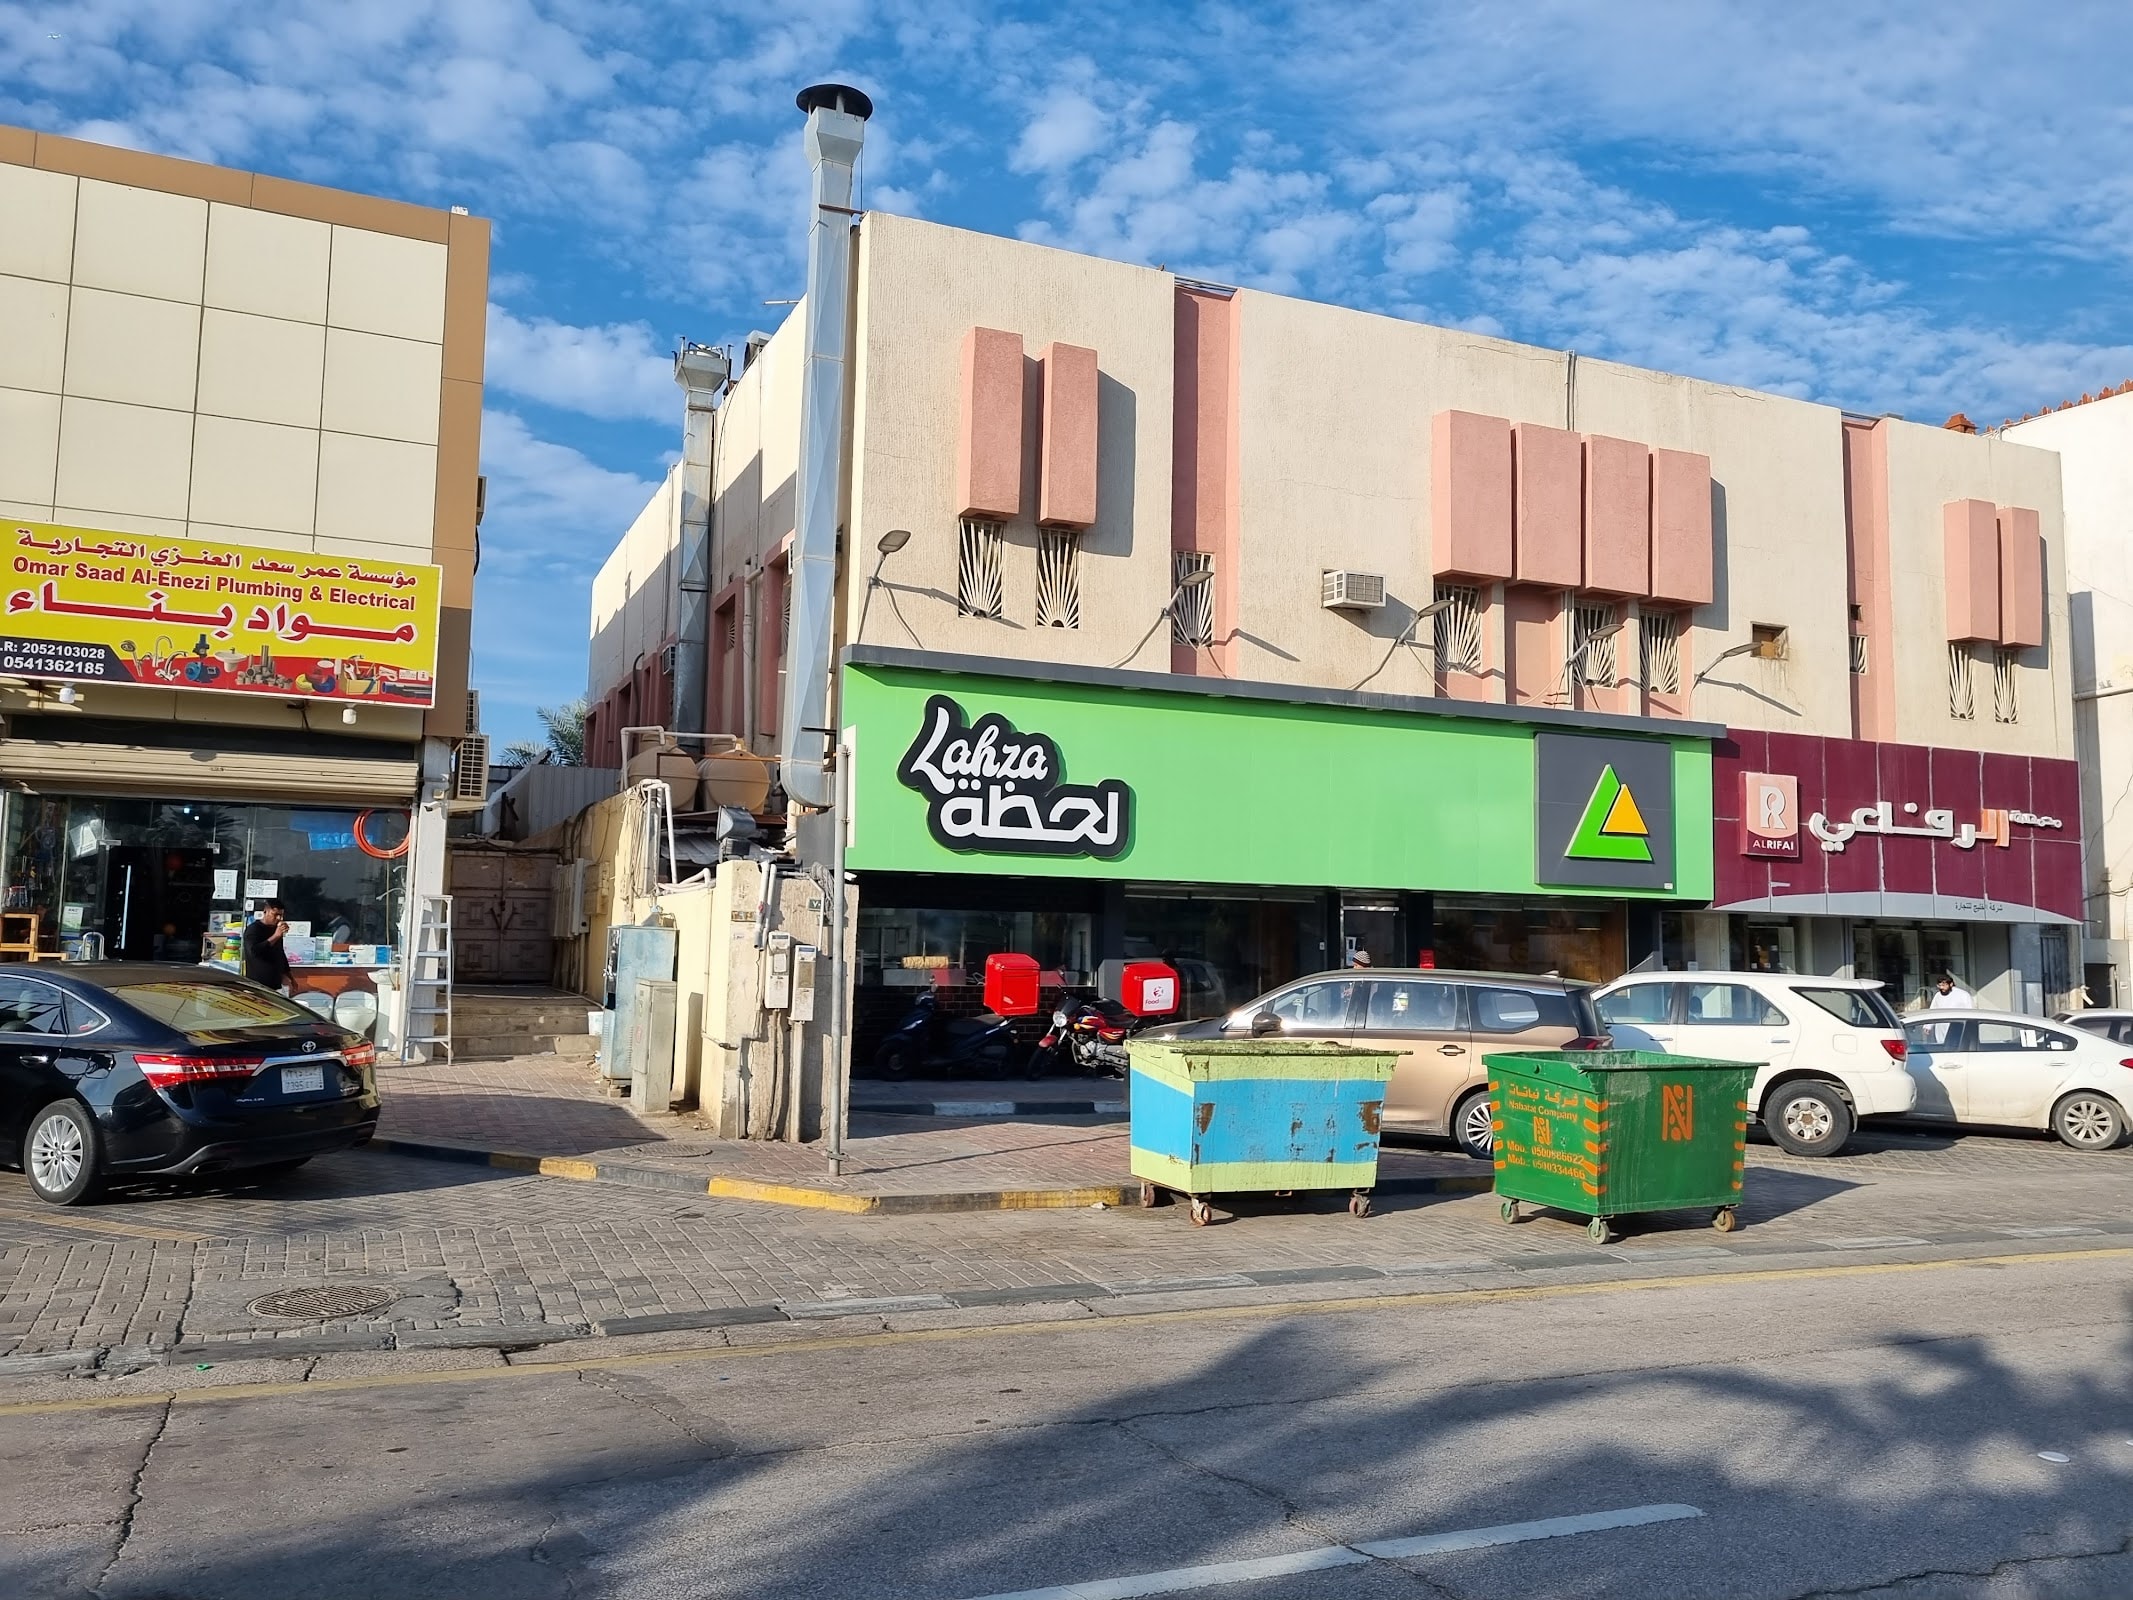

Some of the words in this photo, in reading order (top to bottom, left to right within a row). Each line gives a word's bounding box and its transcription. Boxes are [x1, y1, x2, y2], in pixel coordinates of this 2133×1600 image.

[18, 528, 145, 558] التجارية
[150, 547, 241, 569] العنزي
[251, 558, 295, 573] سعد
[13, 556, 70, 577] Omar
[75, 562, 125, 583] Saad
[131, 568, 210, 591] Al-Enezi
[216, 576, 303, 602] Plumbing
[309, 586, 323, 601] &
[329, 588, 415, 611] Electrical
[299, 565, 342, 579] عمر
[348, 564, 417, 588] مؤسسة
[9, 582, 233, 639] بناء
[247, 604, 415, 643] مواد
[22, 642, 106, 660] 2052103028
[3, 656, 105, 675] 0541362185
[909, 706, 1049, 795] Lahza
[940, 777, 1120, 846] لحظة
[1808, 800, 2010, 850] الرفاعي
[1752, 839, 1795, 851] ALRIFAI
[1543, 1087, 1579, 1108] شركة
[1538, 1105, 1579, 1124] Company
